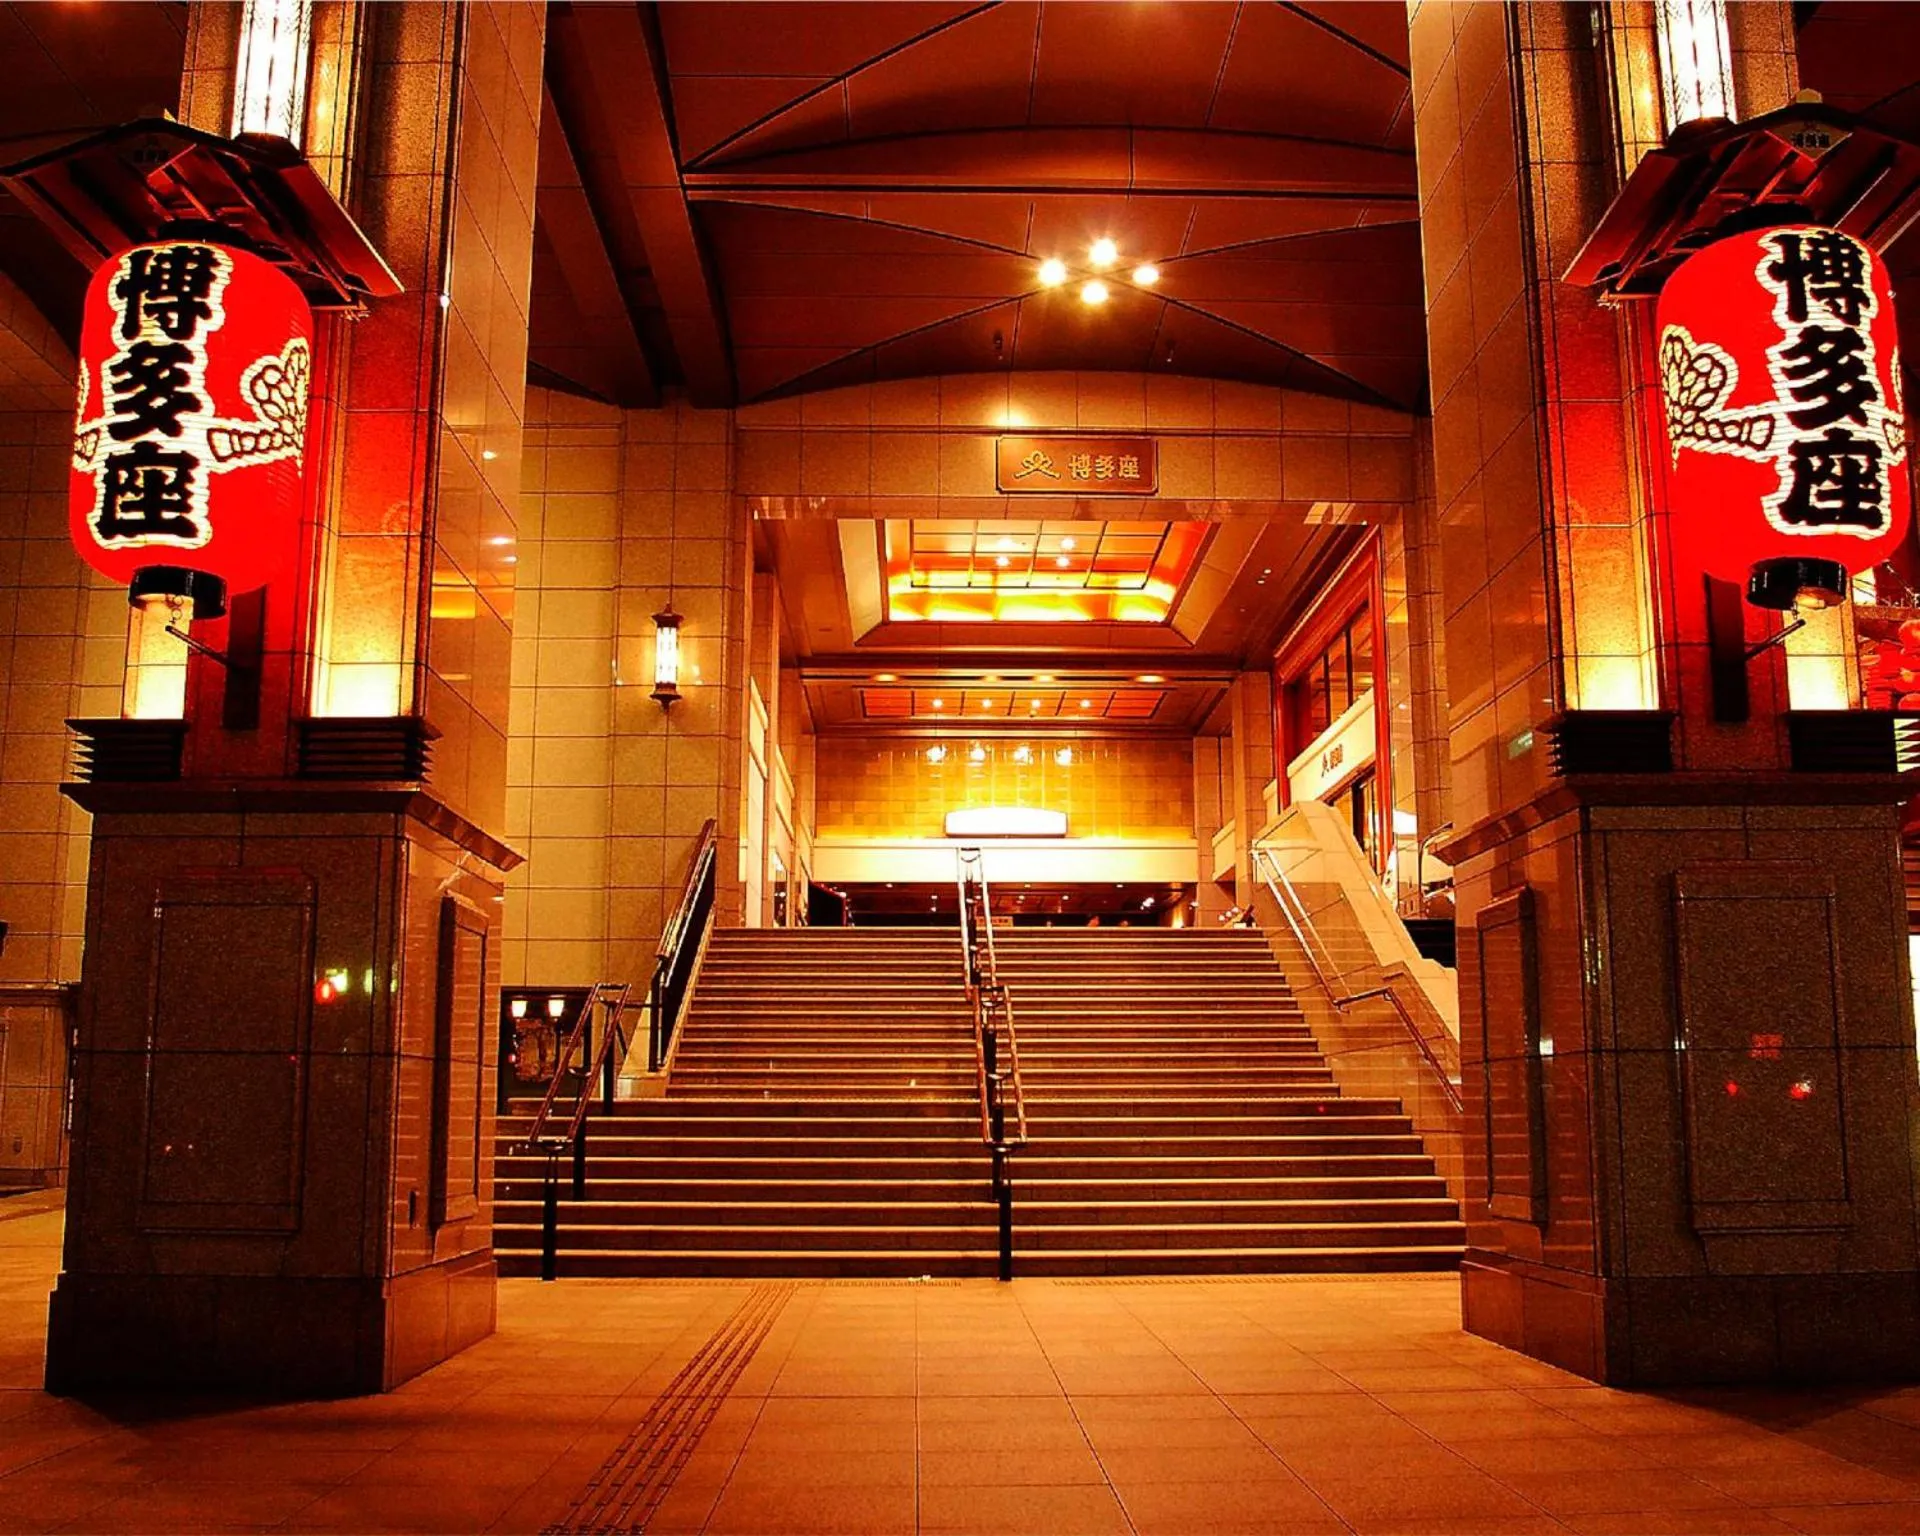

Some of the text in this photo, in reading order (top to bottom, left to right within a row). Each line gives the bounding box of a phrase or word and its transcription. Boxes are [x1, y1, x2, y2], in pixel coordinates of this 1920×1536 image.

[94, 245, 221, 540] 博多座
[1067, 454, 1141, 480] 博多座
[1767, 230, 1883, 530] 博多座
